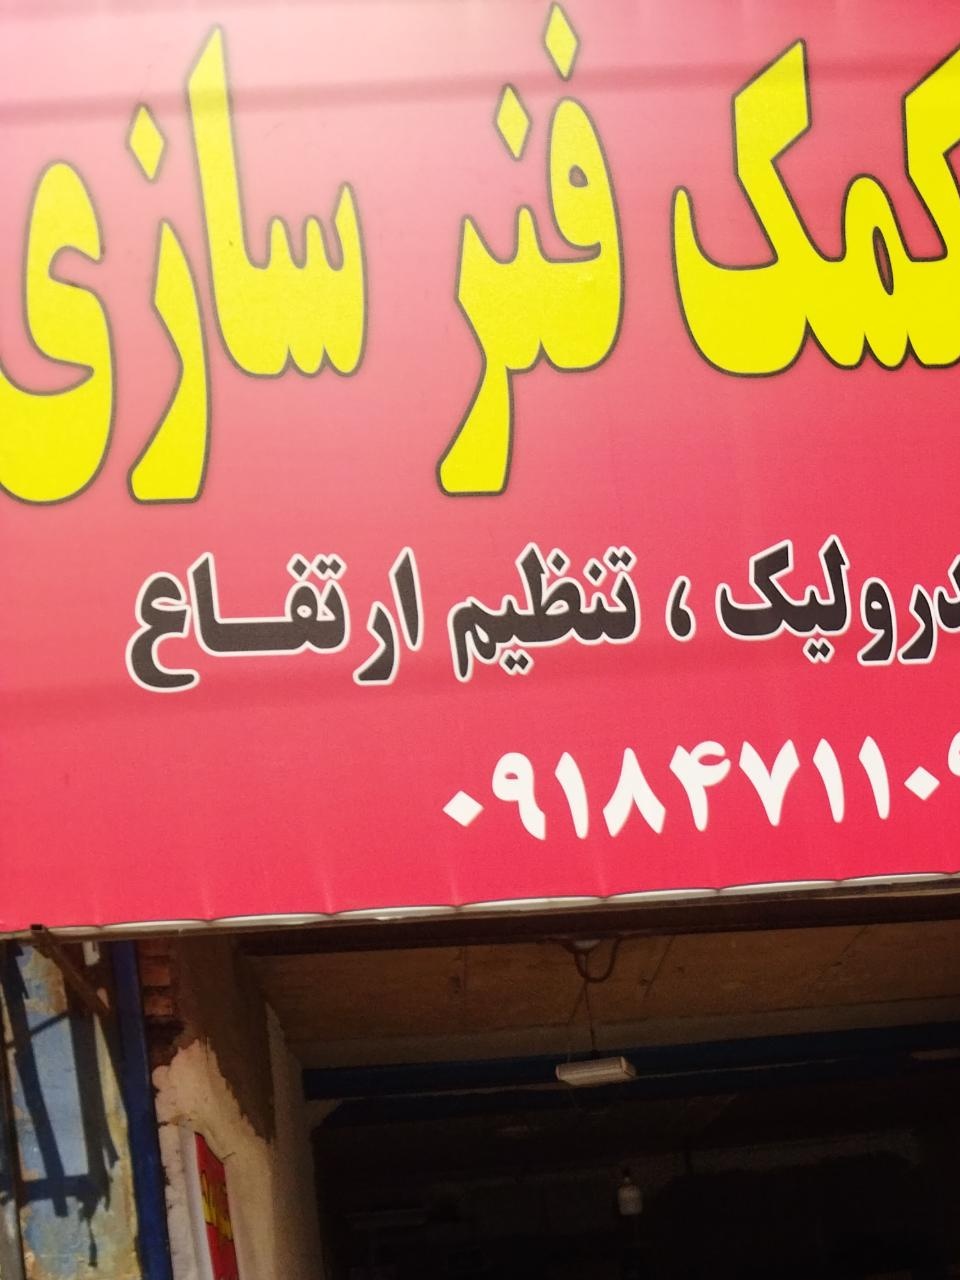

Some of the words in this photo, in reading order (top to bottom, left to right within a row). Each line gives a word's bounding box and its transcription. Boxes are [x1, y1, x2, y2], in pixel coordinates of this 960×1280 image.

[0, 25, 368, 505] سازی
[436, 2, 624, 496] فنر
[126, 548, 422, 691] ارتفاع
[449, 544, 639, 681] تنظیم
